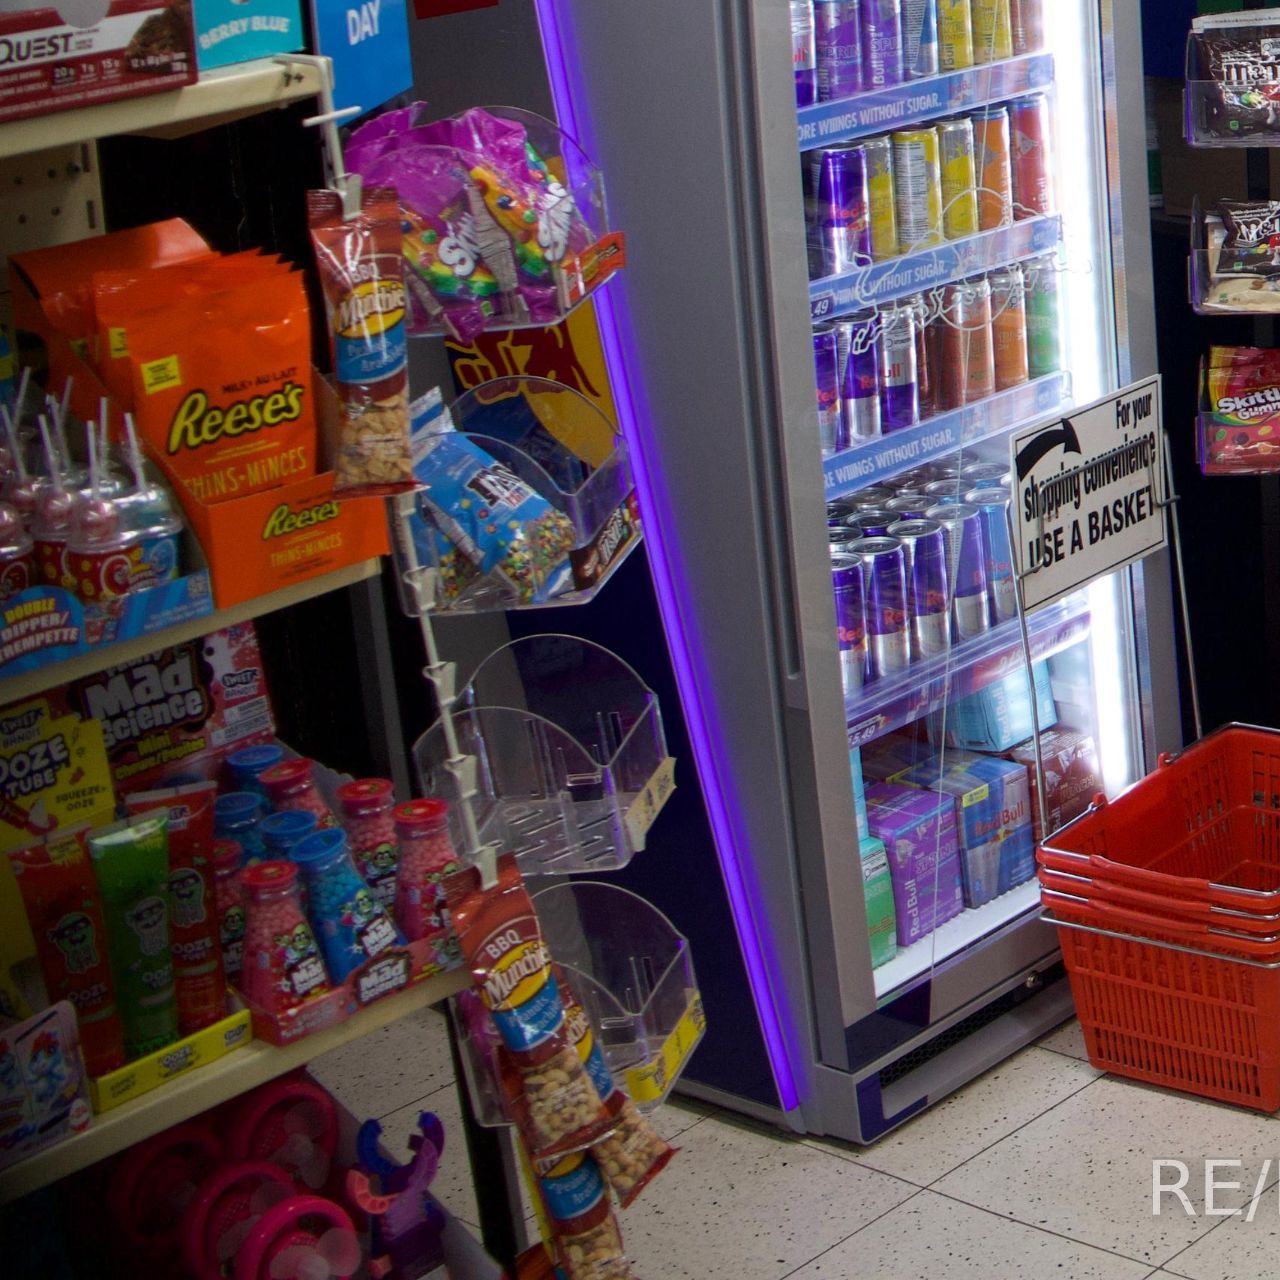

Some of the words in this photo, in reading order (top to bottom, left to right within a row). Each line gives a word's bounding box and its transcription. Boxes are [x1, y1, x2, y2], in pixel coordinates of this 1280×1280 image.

[347, 0, 381, 45] DAY
[168, 381, 304, 456] Reese's
[1116, 399, 1130, 429] For
[1133, 393, 1152, 428] your
[1024, 462, 1081, 523] shopping
[1083, 431, 1156, 495] convenience
[1029, 527, 1065, 573] USE
[1070, 519, 1083, 555] A
[1088, 485, 1154, 545] BASKET
